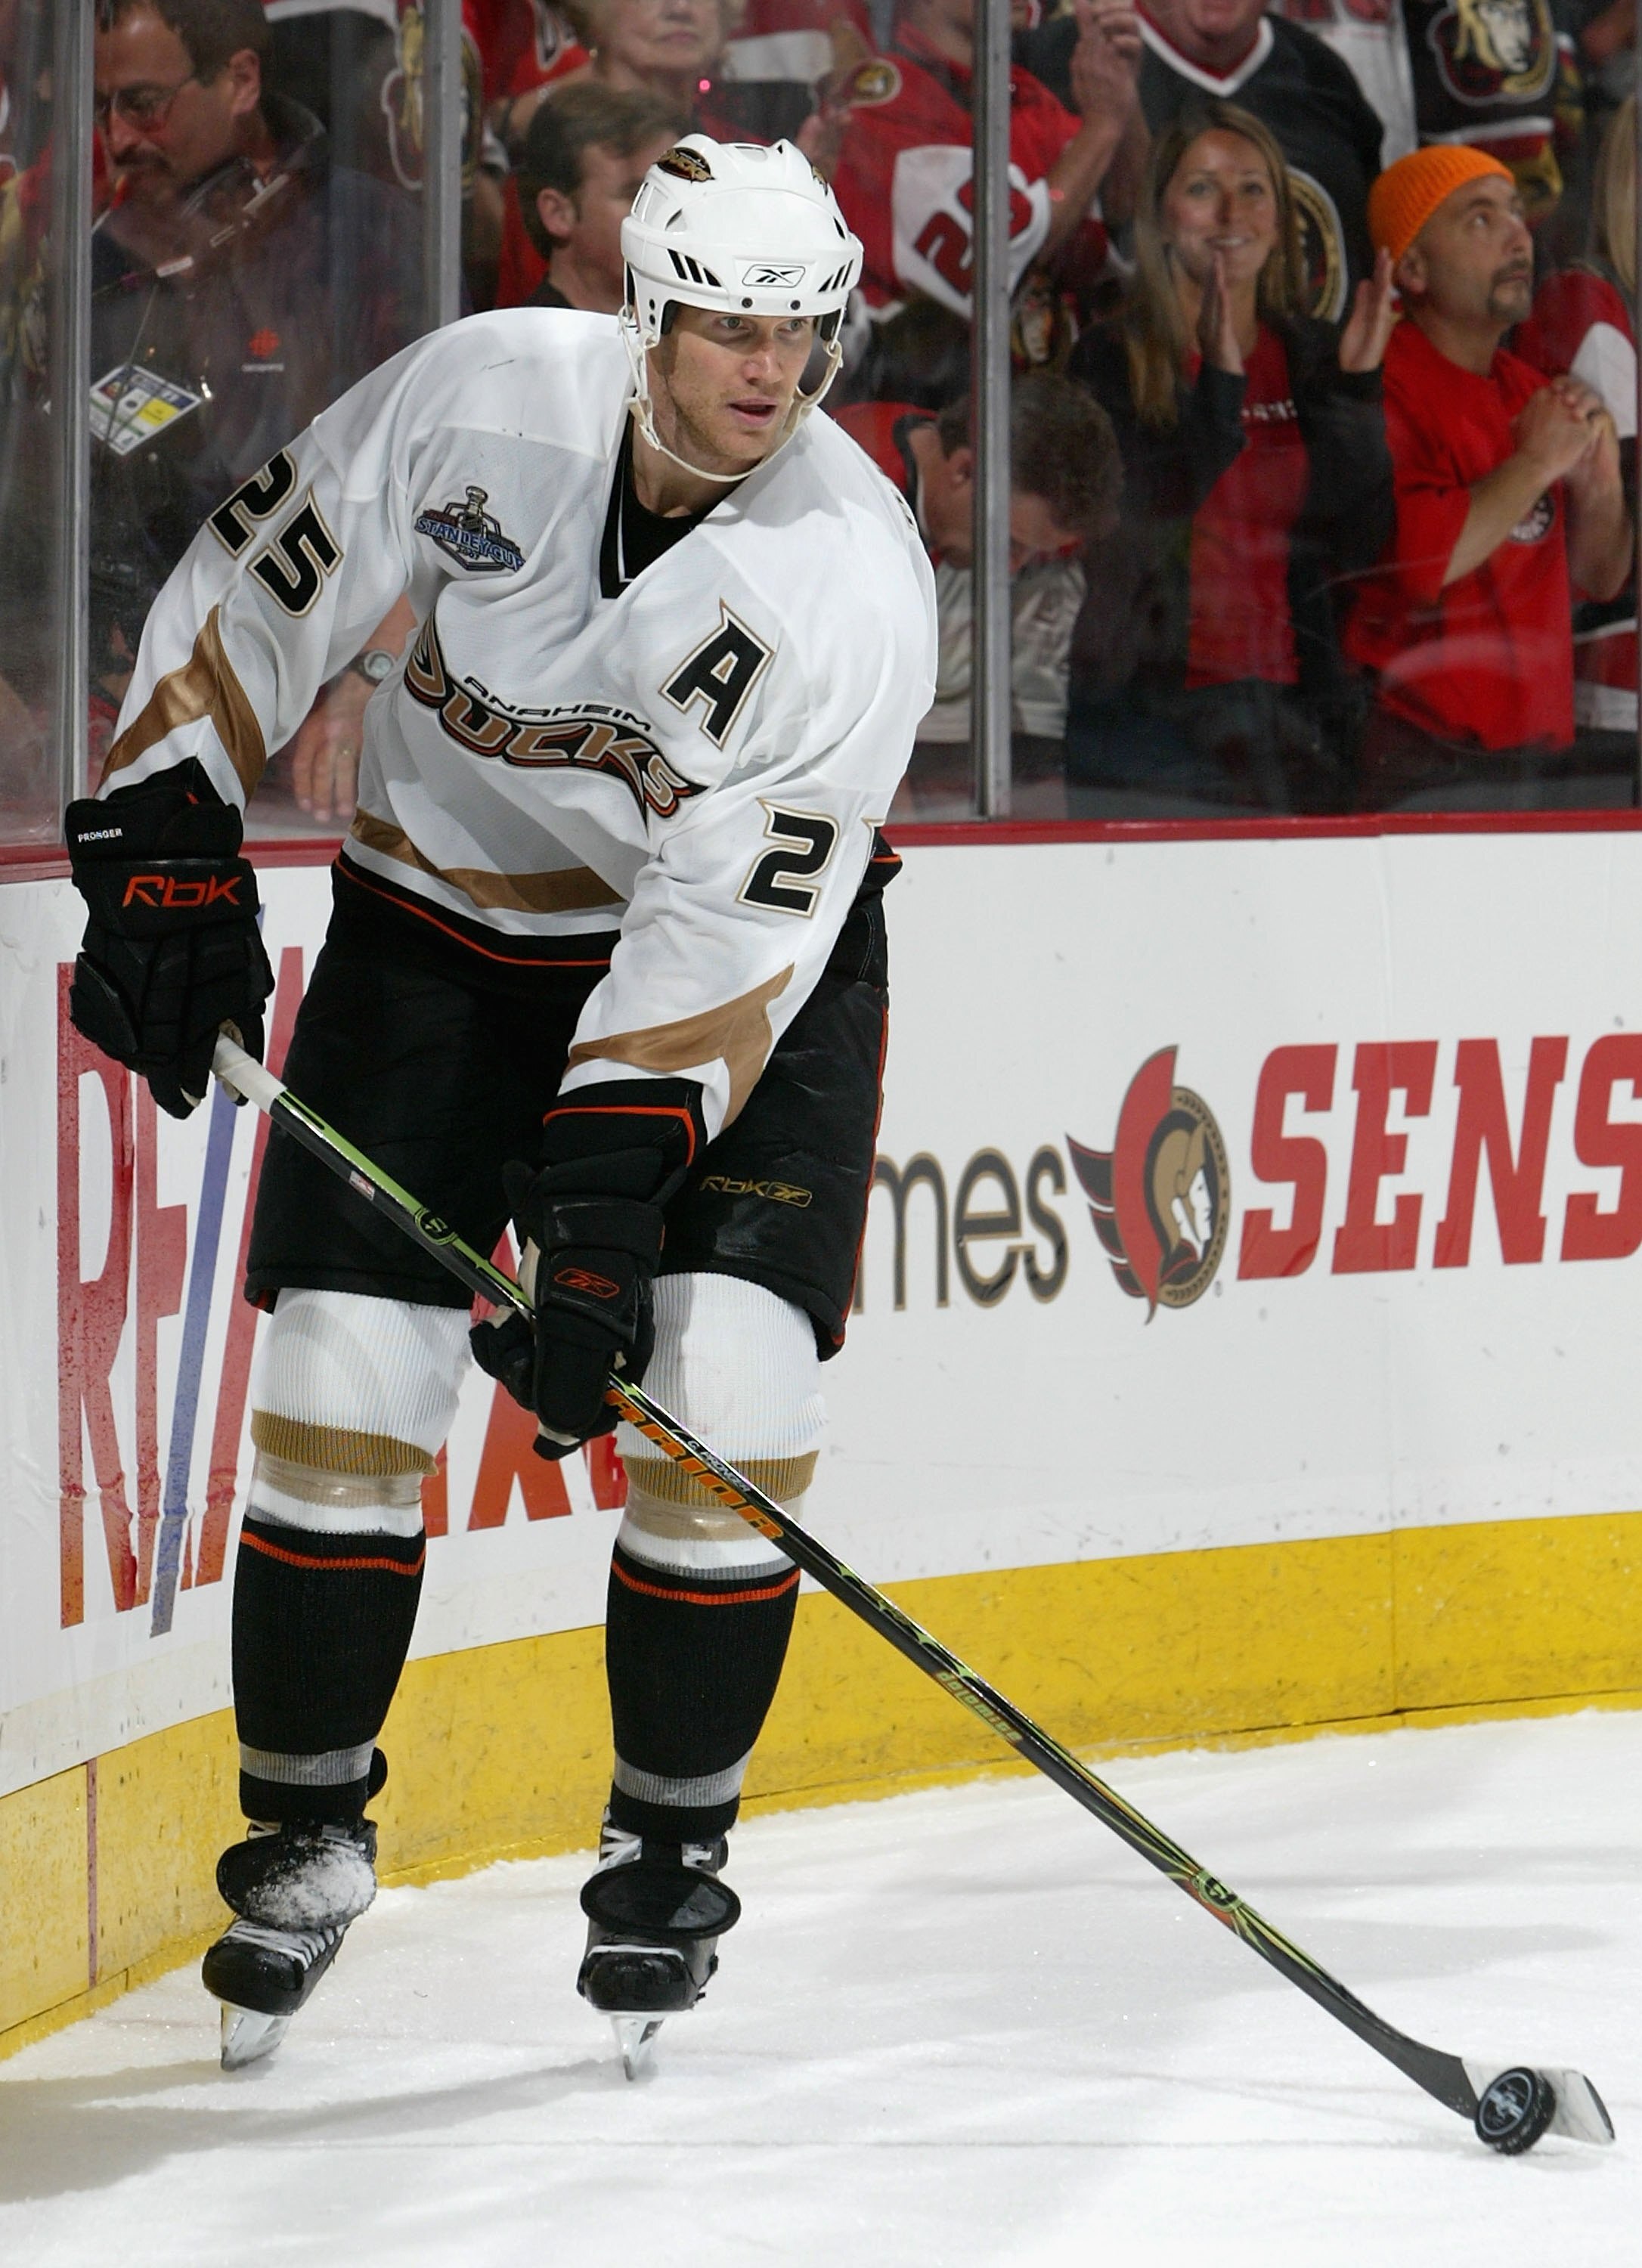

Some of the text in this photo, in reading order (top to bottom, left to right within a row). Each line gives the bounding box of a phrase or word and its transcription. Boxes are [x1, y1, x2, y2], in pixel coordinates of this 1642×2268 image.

[206, 449, 344, 618] 25
[416, 516, 490, 556] STANLEY
[404, 605, 711, 836] DUCKS
[463, 677, 652, 732] ANAHEIM
[658, 598, 775, 751] A
[78, 828, 122, 843] PRONGER
[735, 798, 885, 919] 2
[852, 1145, 1069, 1314] mes
[1237, 1033, 1642, 1281] SENS
